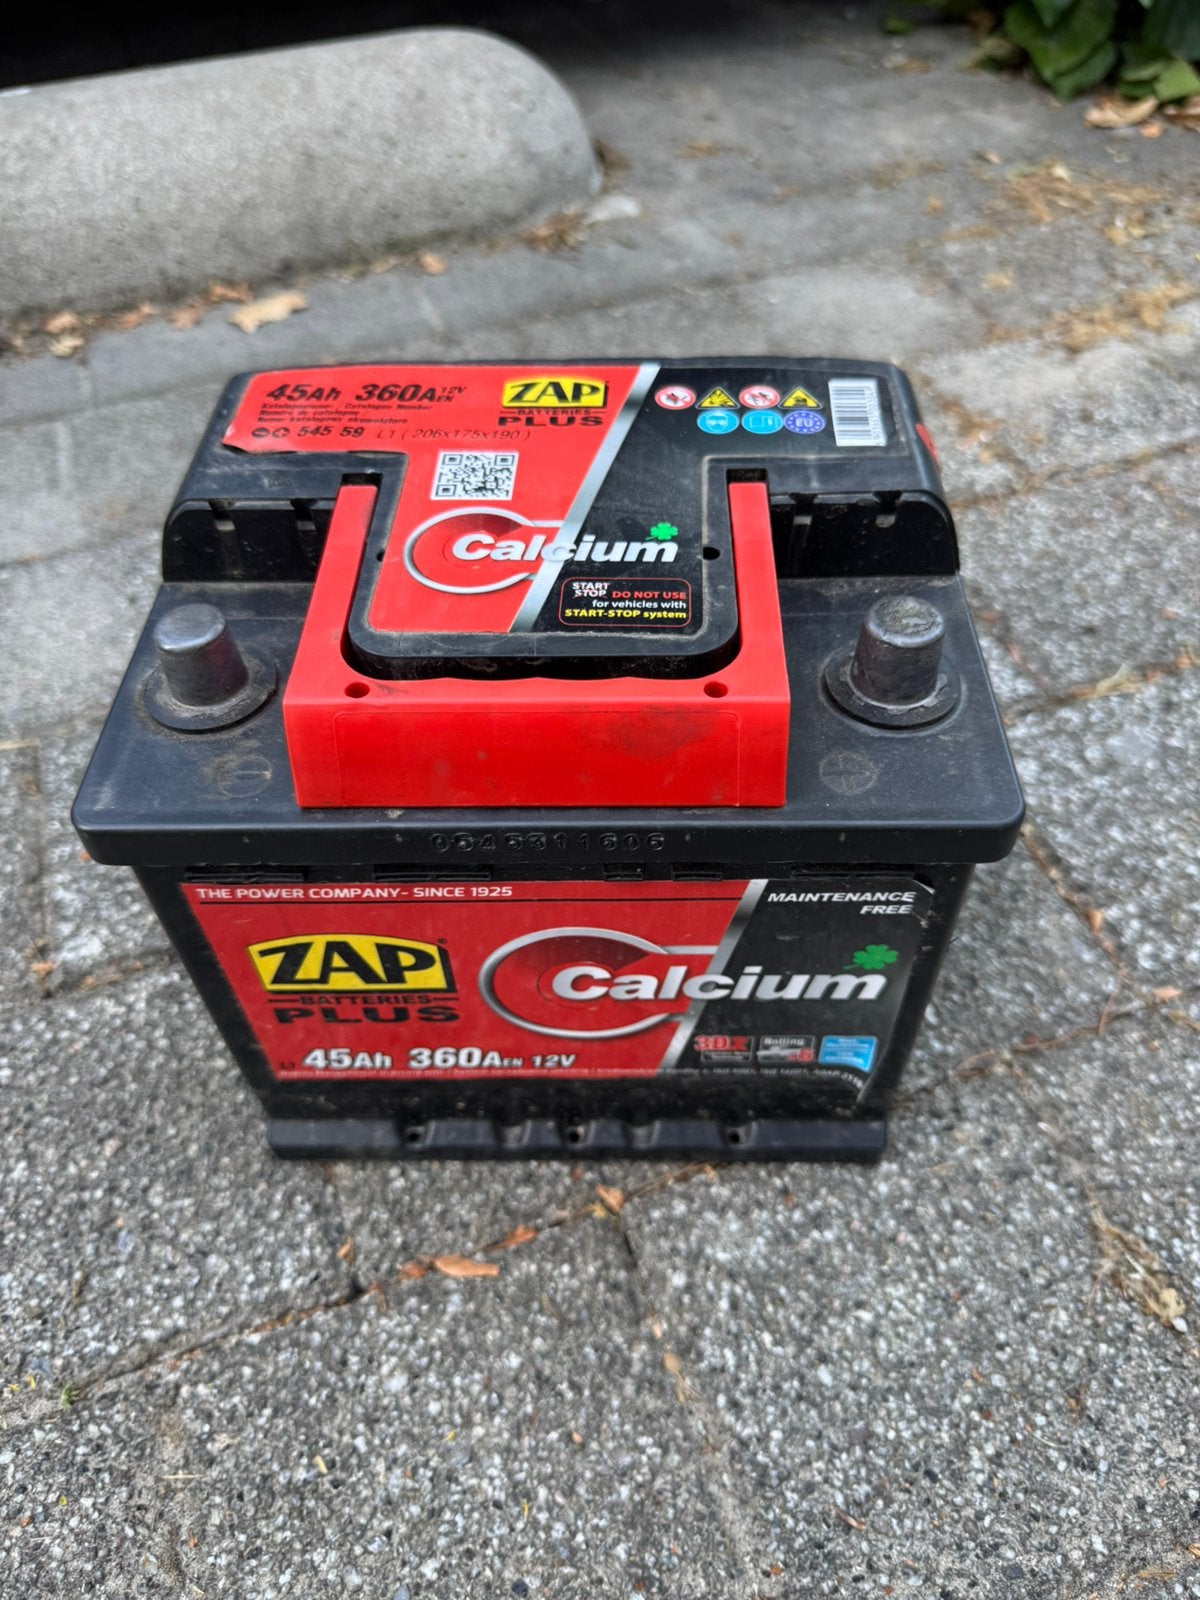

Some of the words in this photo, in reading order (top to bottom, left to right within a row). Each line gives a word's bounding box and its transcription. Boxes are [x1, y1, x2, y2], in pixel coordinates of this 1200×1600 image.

[265, 384, 341, 401] 45Ah
[440, 386, 467, 394] 12V
[507, 381, 601, 403] ZAP
[498, 416, 603, 426] PLUS
[796, 416, 813, 427] EU
[297, 426, 333, 437] 545
[339, 426, 365, 438] 59
[452, 533, 678, 562] Calcium
[572, 582, 610, 590] START
[633, 591, 660, 599] NOT
[592, 600, 609, 608] for
[611, 600, 658, 609] vehicles
[660, 601, 687, 609] with
[564, 609, 641, 618] START-STOP
[643, 610, 687, 619] system
[196, 888, 232, 899] THE
[236, 887, 304, 899] POWER
[413, 886, 465, 898] SINCE
[471, 886, 513, 897] 1925
[767, 891, 916, 903] MAINTENANCE
[859, 904, 913, 914] FREE
[258, 941, 437, 985] ZAP
[552, 965, 887, 1001] Calcium
[300, 996, 432, 1005] BATTERIES
[273, 1006, 460, 1024] PLUS
[304, 1048, 392, 1070] 45Ah
[531, 1054, 576, 1068] 12V
